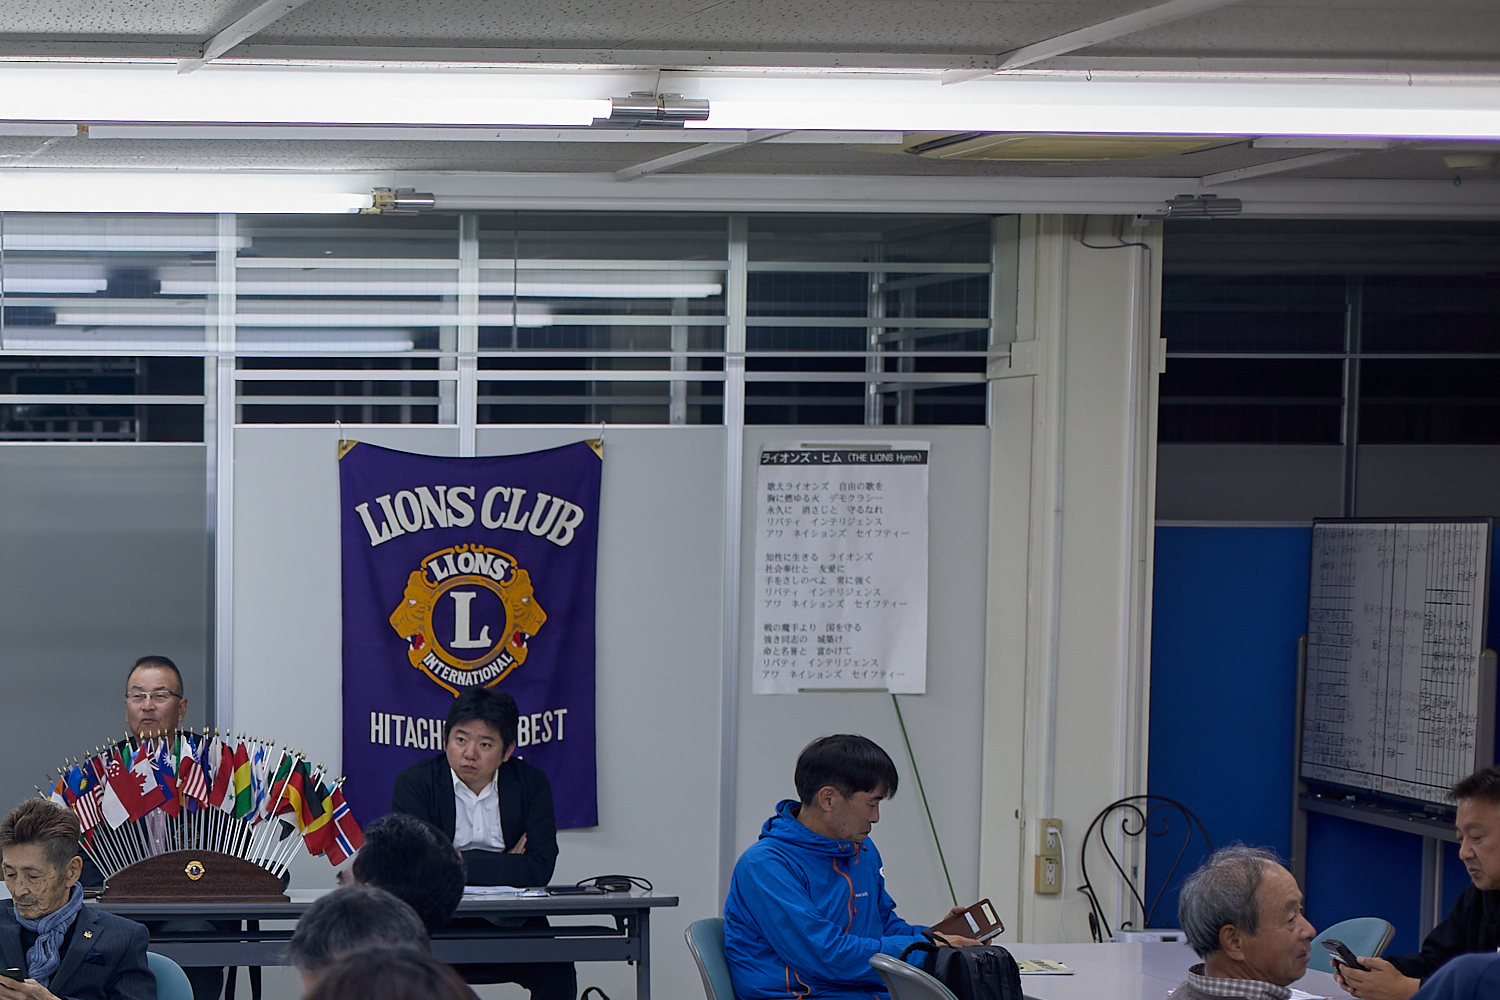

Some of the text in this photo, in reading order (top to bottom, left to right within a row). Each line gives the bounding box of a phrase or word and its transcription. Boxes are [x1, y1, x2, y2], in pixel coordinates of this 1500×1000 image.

[761, 452, 842, 464] ライオンズ・ヒム
[870, 453, 894, 463] LIONS
[767, 482, 884, 491] 歌えライオンズ 自由の歌を
[829, 494, 884, 503] デモクラシー
[767, 506, 792, 515] 永久に
[847, 506, 883, 515] 守るなれ
[355, 485, 585, 547] LIONS CLUB
[811, 518, 882, 527] インテリジェンス
[766, 529, 910, 538] アワ ネイションズ セイフティー
[766, 553, 873, 562] 知性に生きる ライオンズ
[428, 552, 510, 582] LIONS
[765, 564, 845, 574] 社会奉仕と 友愛に
[810, 588, 881, 597] インテリジェンス
[765, 600, 908, 608] アワ ネイションズ セイフティー
[450, 592, 492, 648] L
[826, 623, 862, 632] 国を守る
[807, 658, 879, 667] インテリジェンス
[423, 652, 514, 686] INTERNATIONAL
[762, 670, 906, 679] アワ ネイションズ セイフティー
[517, 708, 568, 747] BEST
